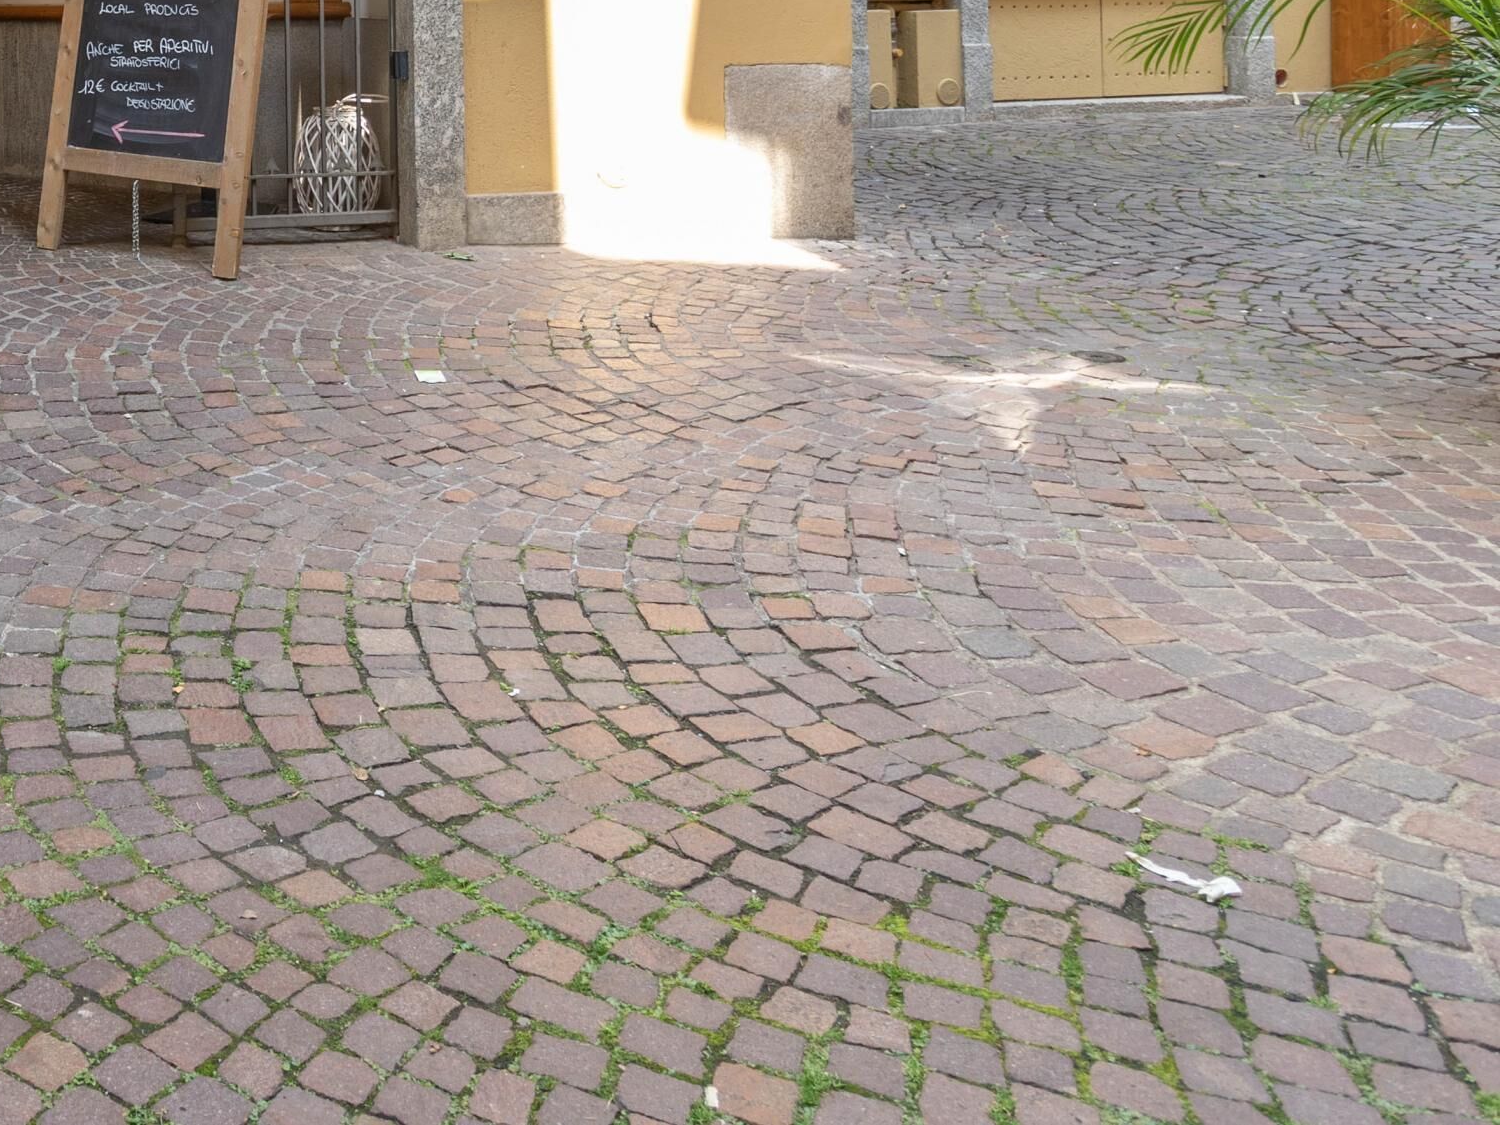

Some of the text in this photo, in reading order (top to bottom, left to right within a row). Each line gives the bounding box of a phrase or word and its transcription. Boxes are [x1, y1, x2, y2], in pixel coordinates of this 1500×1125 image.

[99, 1, 200, 17] LOCAL PRODUCTS
[86, 37, 214, 60] ANCHE PER APERITIVI
[77, 77, 106, 95] 12€
[126, 97, 196, 113] DEGUSTAZIONE
